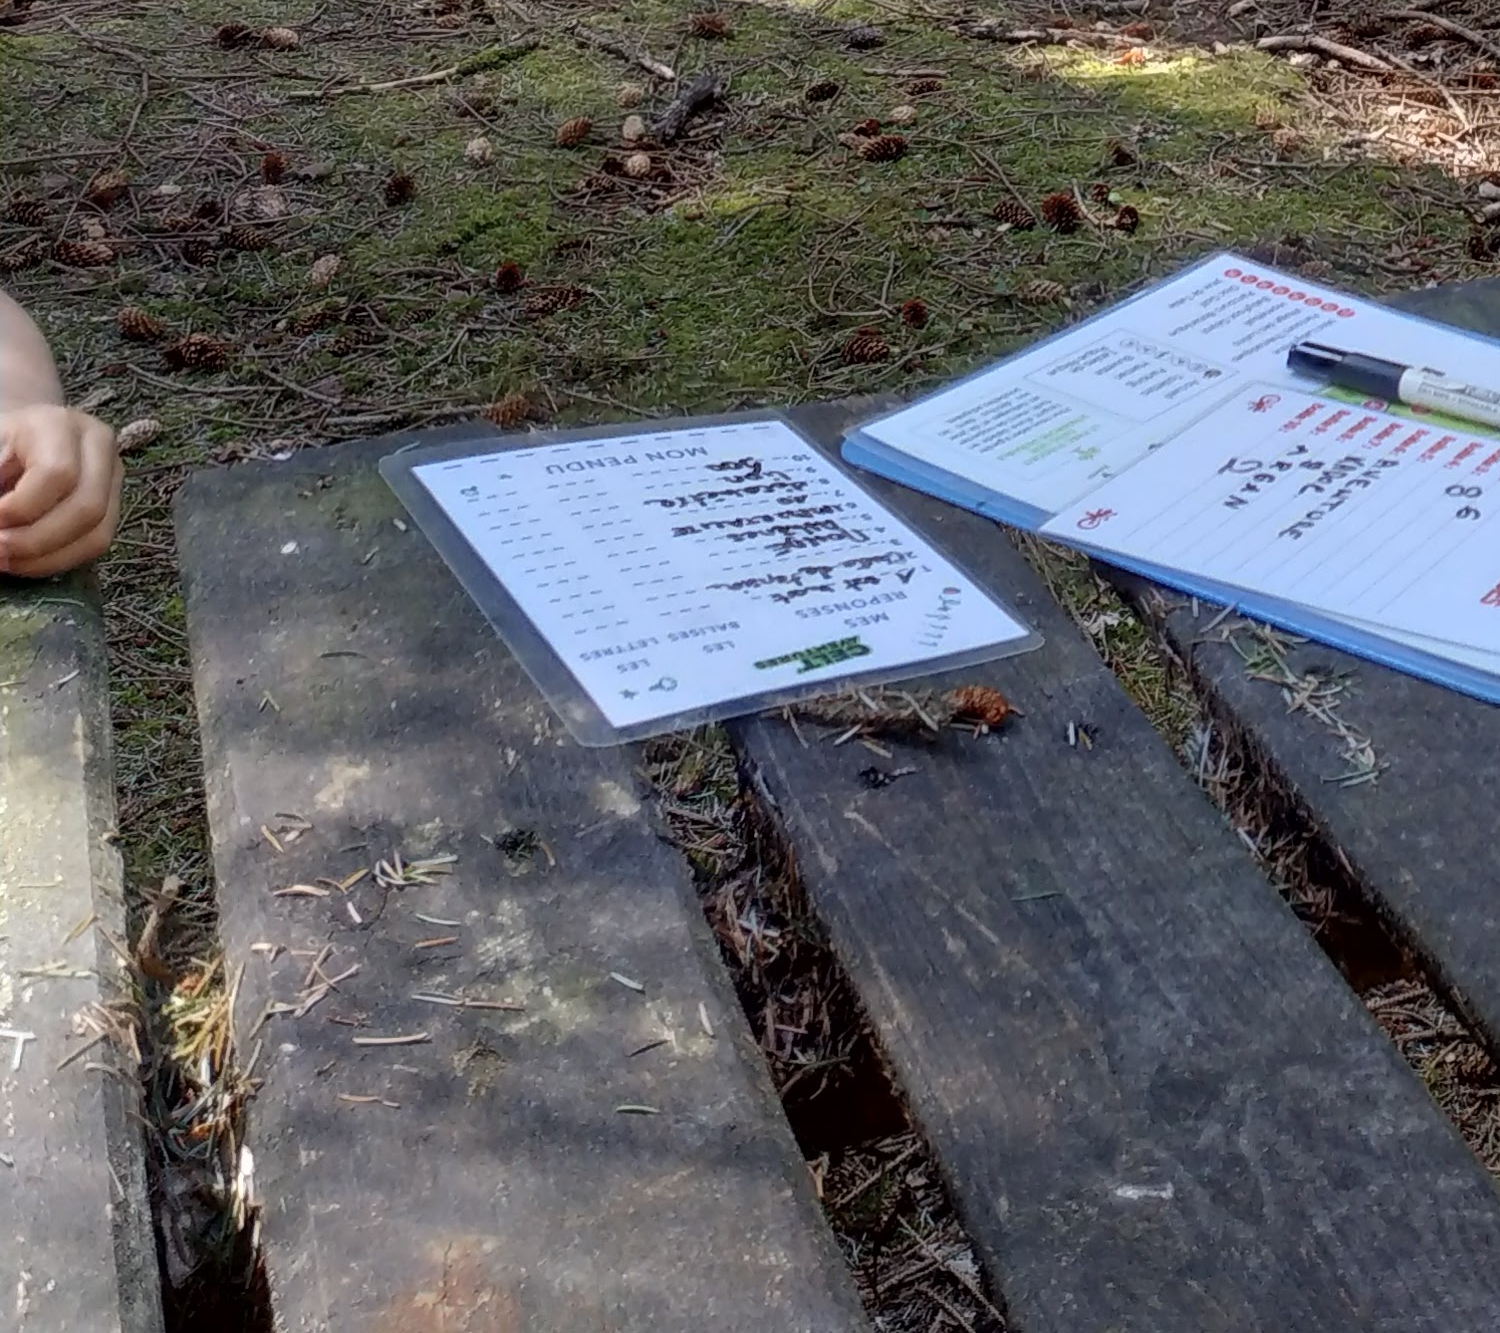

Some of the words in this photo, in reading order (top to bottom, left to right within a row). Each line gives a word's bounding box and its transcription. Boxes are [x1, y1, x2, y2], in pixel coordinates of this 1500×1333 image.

[644, 446, 709, 462] MON
[545, 454, 638, 475] PENDU
[794, 590, 908, 619] REPONSES
[843, 612, 890, 629] MES
[579, 636, 660, 662] LETTRES
[702, 640, 736, 654] LES
[616, 658, 651, 674] LES
